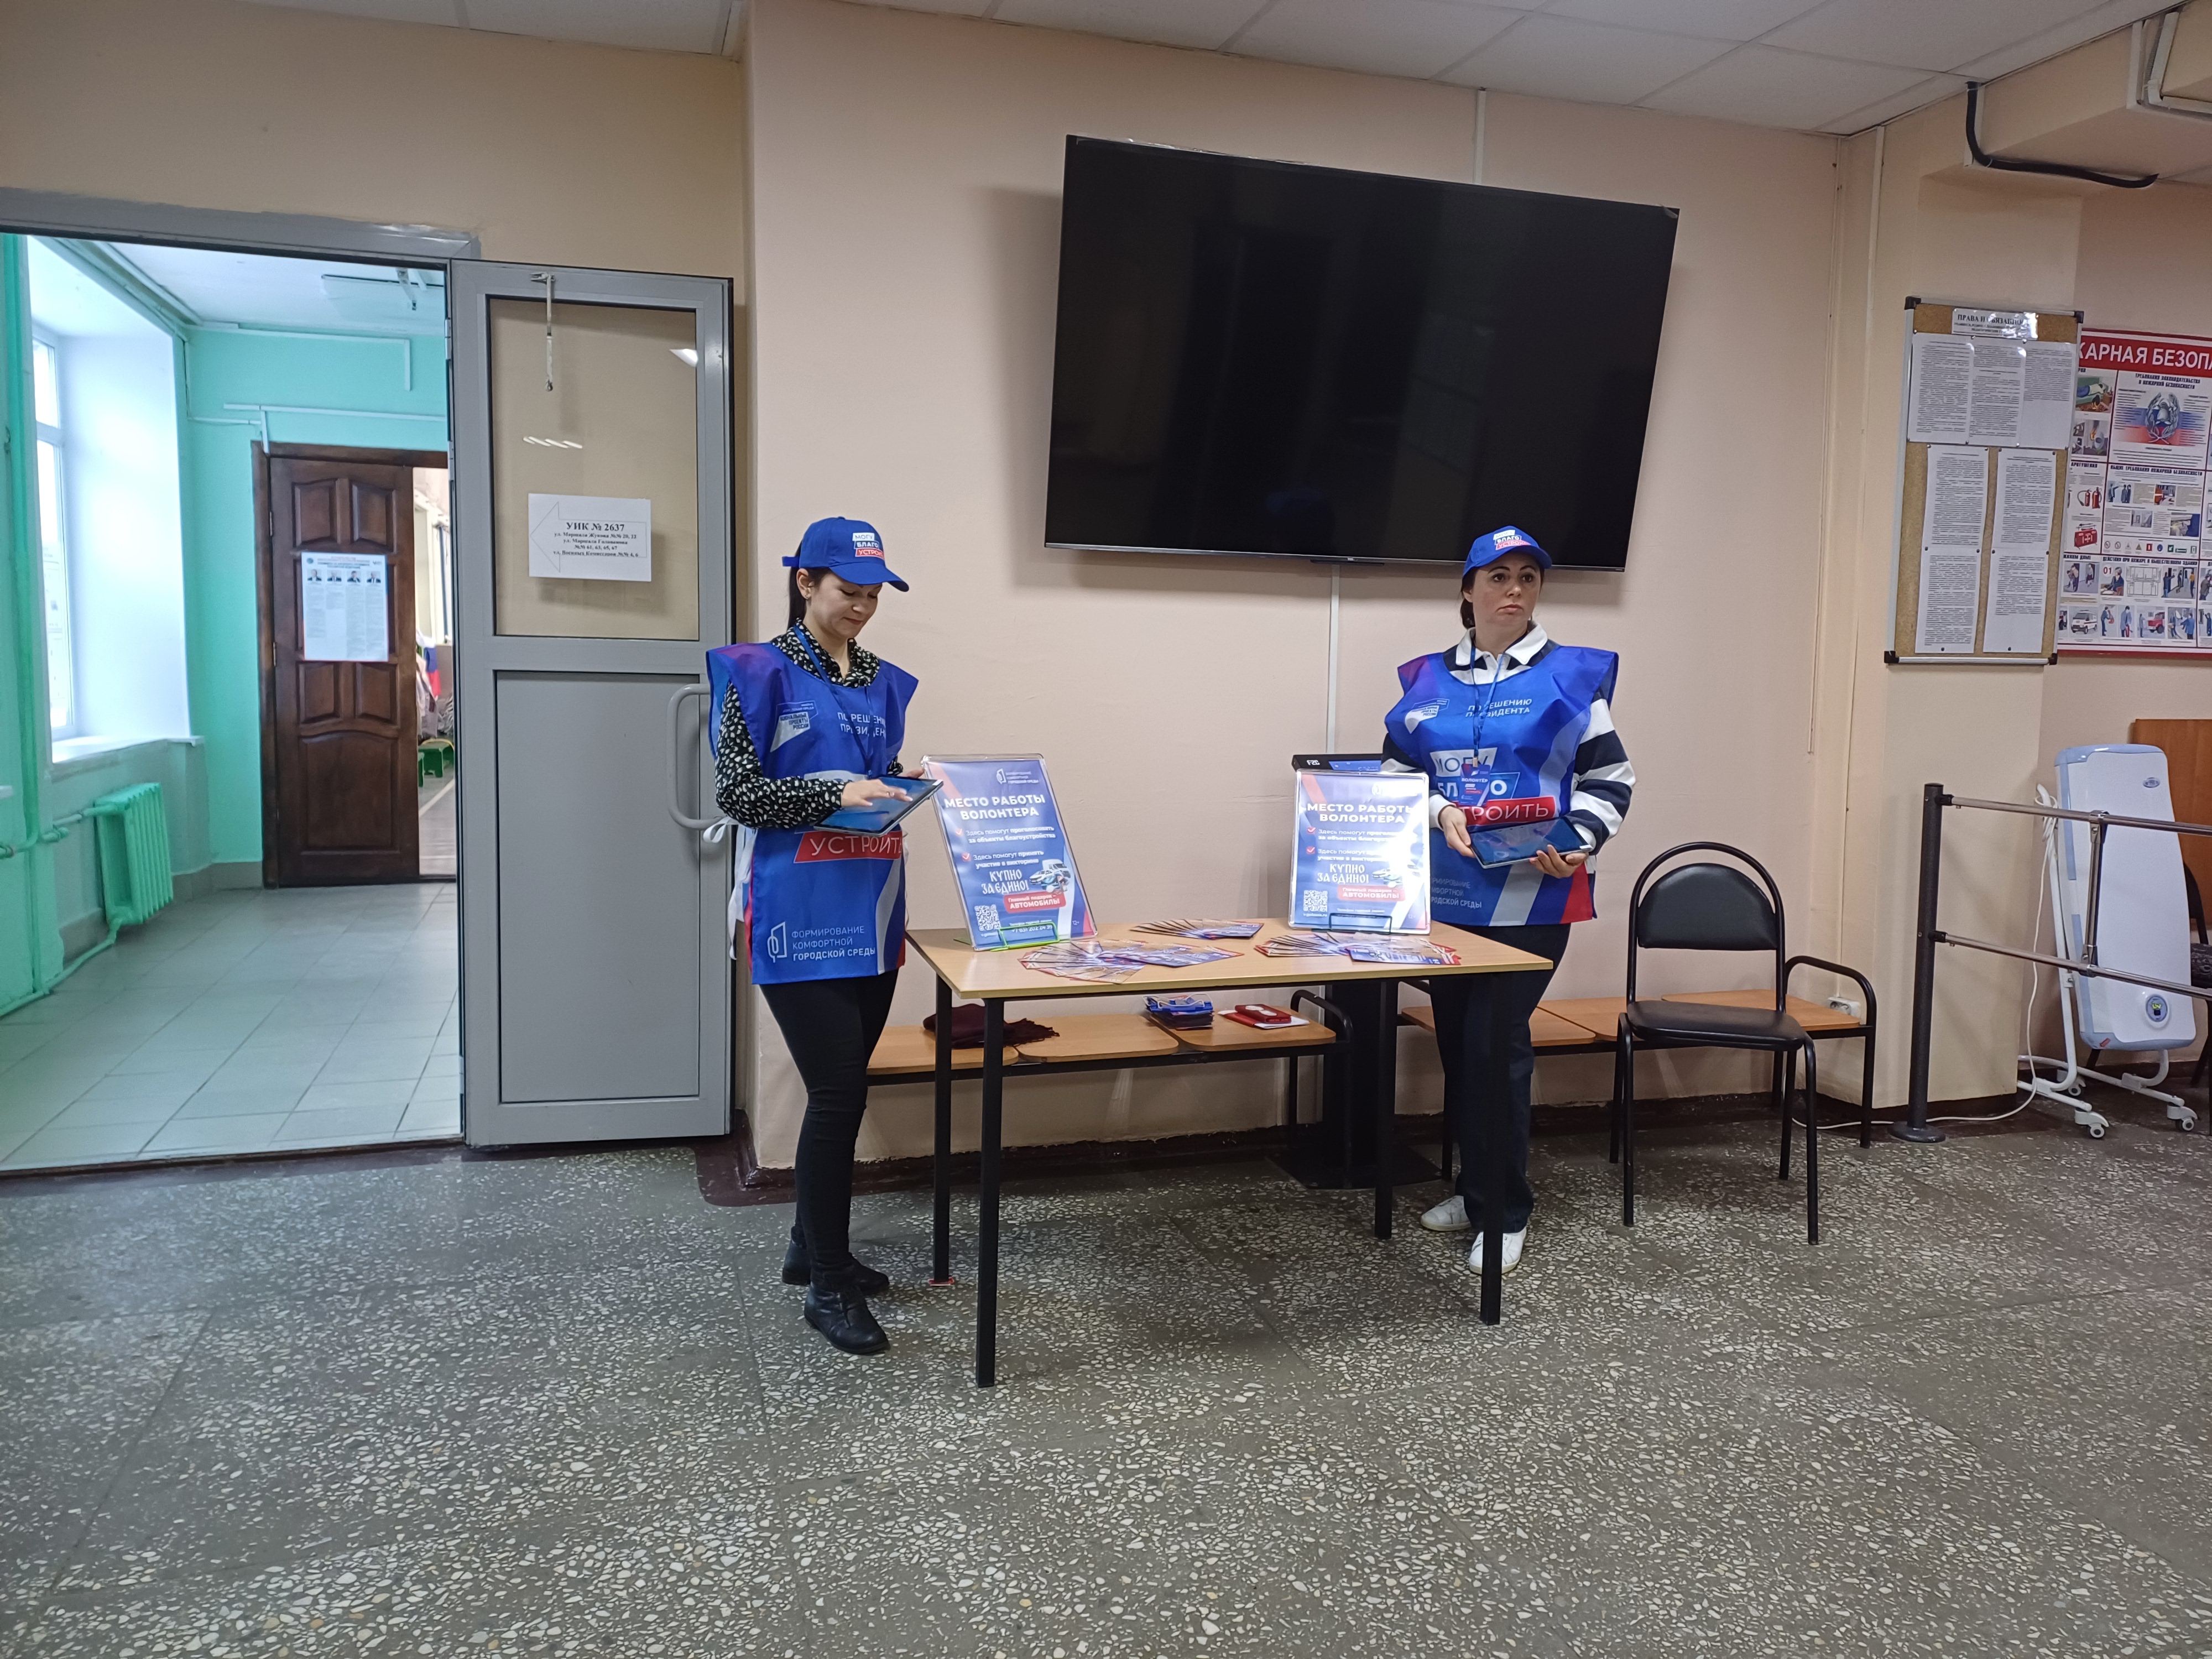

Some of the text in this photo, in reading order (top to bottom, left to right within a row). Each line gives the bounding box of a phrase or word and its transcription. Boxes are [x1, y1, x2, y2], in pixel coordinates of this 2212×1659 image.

[2152, 348, 2212, 370] БЕЗОП
[566, 522, 625, 531] УИК № 2637
[1488, 698, 1532, 709] ЕШЕНИЮ
[1465, 707, 1530, 717] ПЗИДЕНТА
[944, 794, 1046, 808] МЕСТО РАБОТЫ
[1307, 803, 1354, 812] МЕСТО
[960, 807, 1040, 820] ВОЛОНТЕРА
[1319, 813, 1405, 823] ВОЛОНТЕРА
[1329, 863, 1365, 873] КУПНО
[989, 869, 1022, 882] КУПНО
[1317, 873, 1331, 882] ЗА
[981, 883, 995, 894] ЗА
[1460, 900, 1482, 909] СРЕДЫ
[791, 926, 865, 938] ФОРМИРОВАНИЕ
[792, 936, 853, 950] КОМФОРТНОЙ
[793, 947, 876, 962] ГОРОДСКОЙ СРЕДЫ
